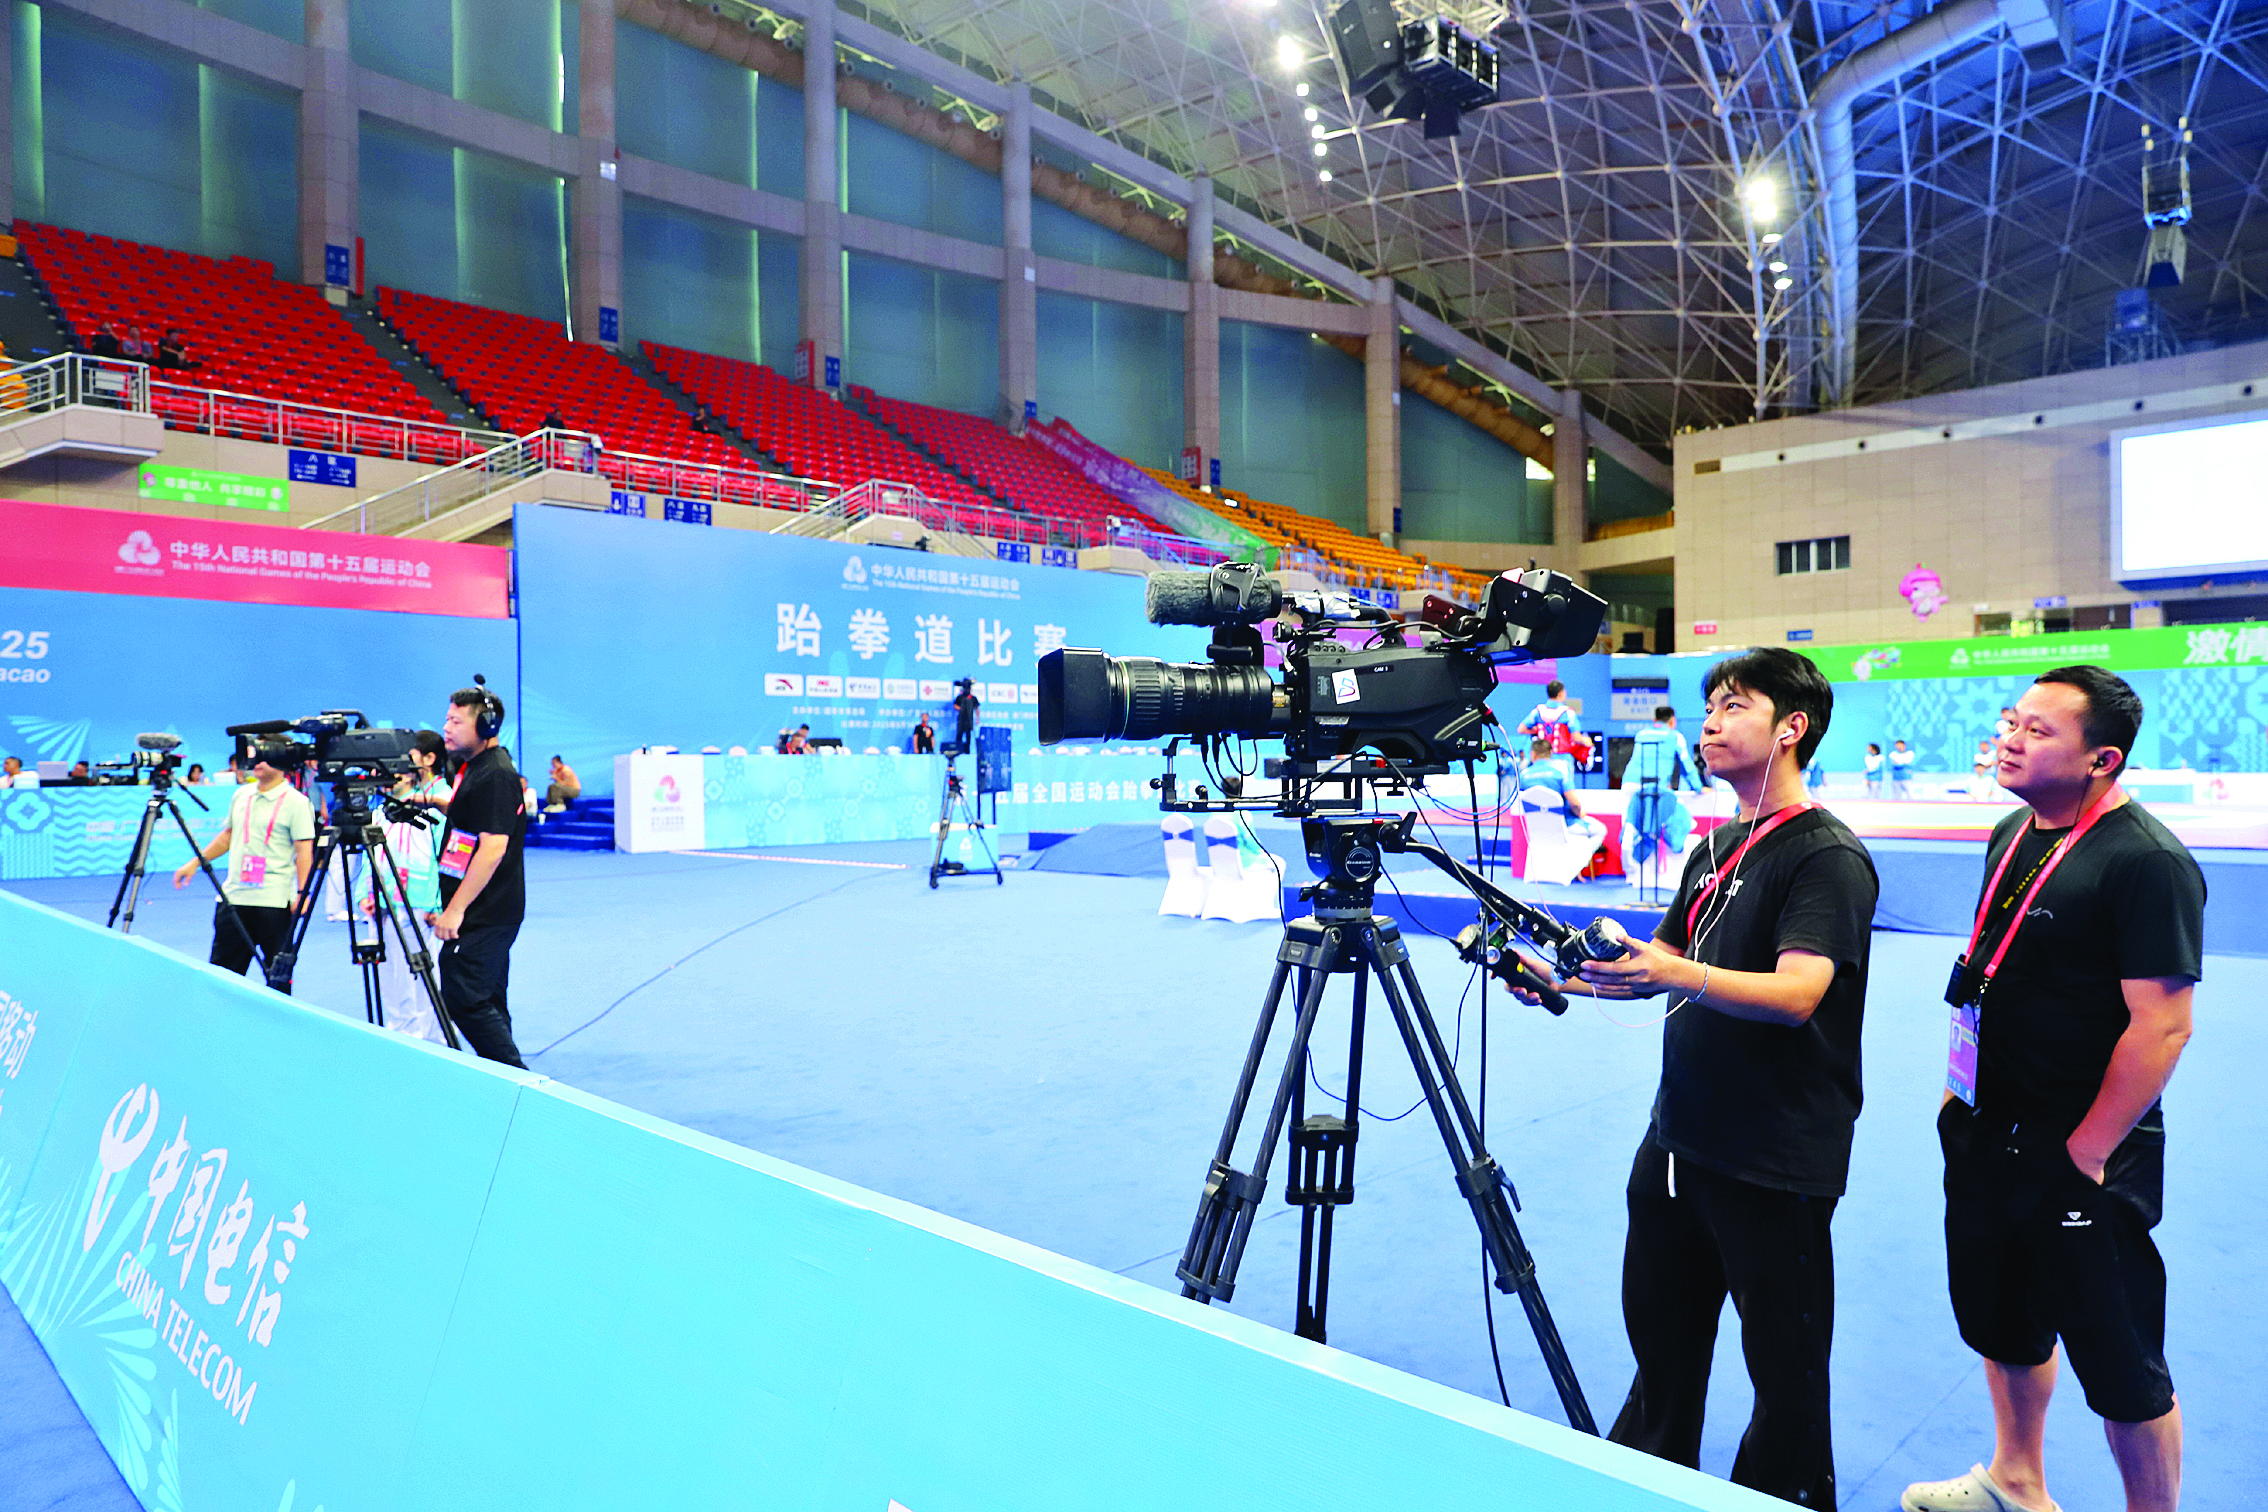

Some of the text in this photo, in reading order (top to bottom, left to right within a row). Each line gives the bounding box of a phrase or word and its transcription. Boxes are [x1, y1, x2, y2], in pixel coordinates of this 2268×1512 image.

[169, 540, 431, 578] 中华人民共和国第十五届运动会
[141, 1115, 310, 1347] 中国电信
[116, 1250, 258, 1427] CHINA TELECOM
